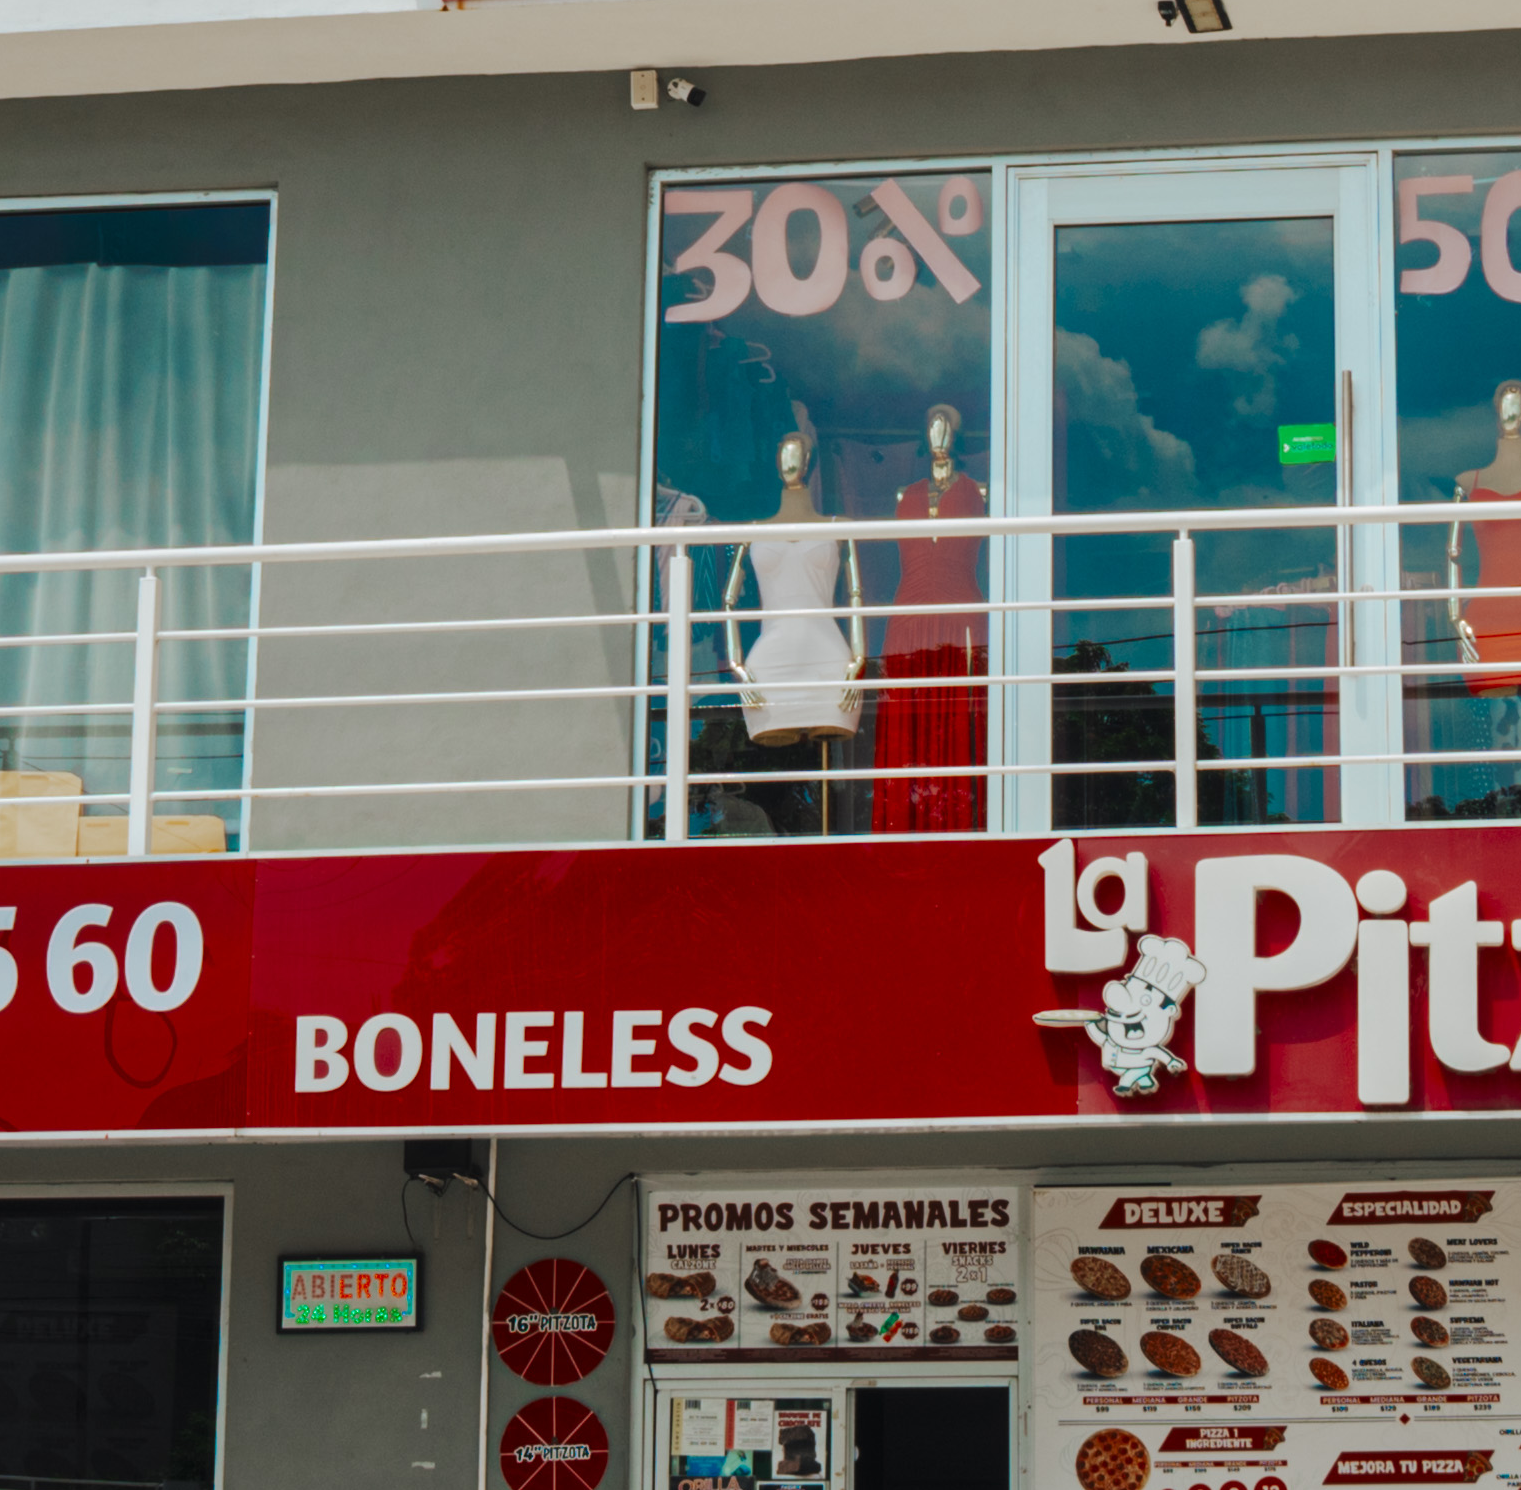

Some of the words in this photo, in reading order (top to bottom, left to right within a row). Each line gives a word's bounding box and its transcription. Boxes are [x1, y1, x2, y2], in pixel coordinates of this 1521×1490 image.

[45, 900, 205, 1014] 60
[294, 1005, 774, 1093] BONELESS
[658, 1202, 795, 1232] PROMOS
[808, 1198, 1011, 1230] SEMANALES
[1124, 1200, 1225, 1224] DELUXE
[1342, 1200, 1462, 1218] ESPECIALIDAD
[667, 1244, 721, 1259] LUNES
[851, 1243, 912, 1256] JUEVES
[942, 1241, 1007, 1256] VIERNES
[291, 1272, 408, 1301] ABIERTO
[295, 1303, 327, 1325] 24
[332, 1303, 403, 1325] Horas
[539, 1313, 597, 1333] PITZOTA
[542, 1443, 591, 1462] PITZOTA
